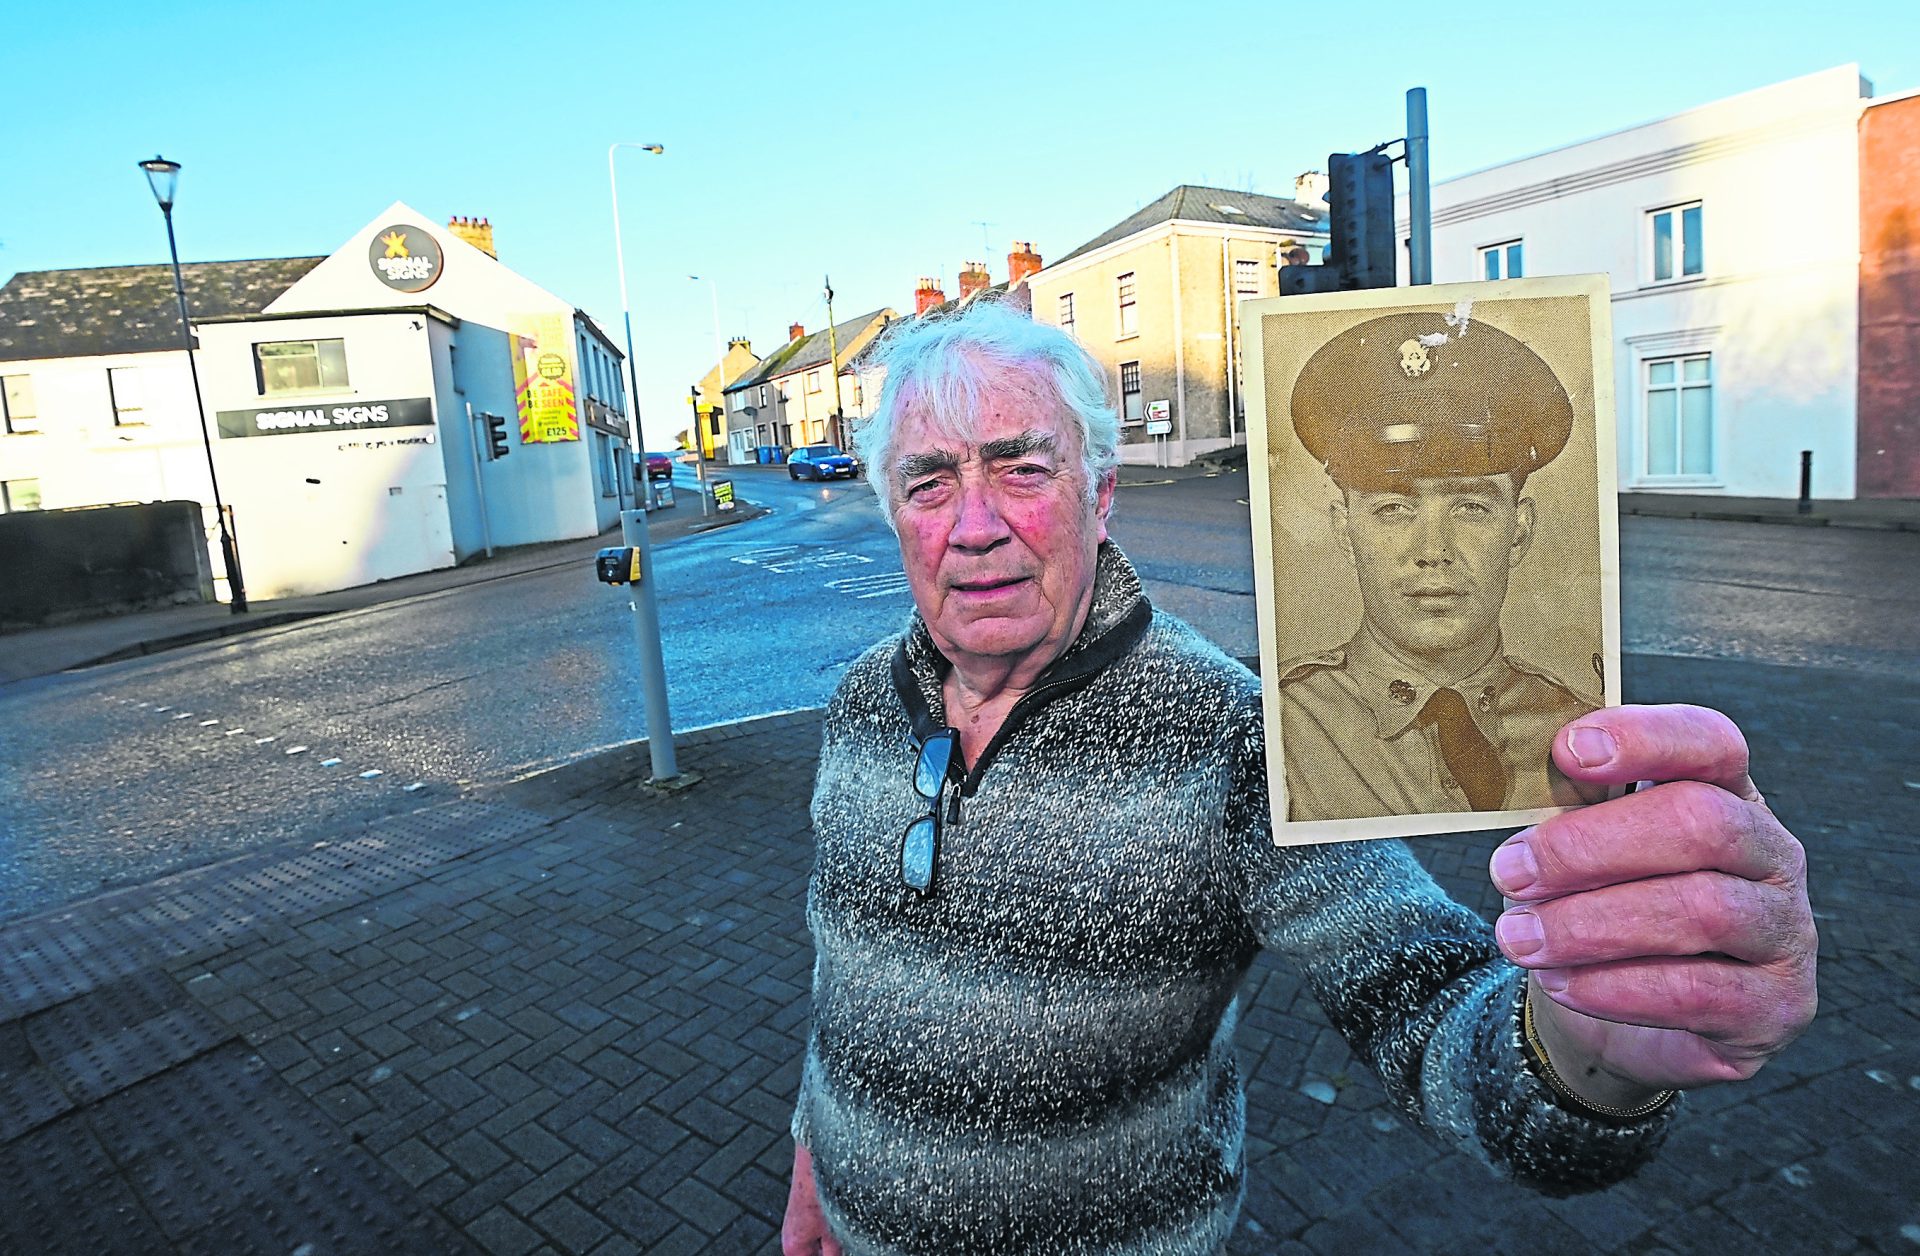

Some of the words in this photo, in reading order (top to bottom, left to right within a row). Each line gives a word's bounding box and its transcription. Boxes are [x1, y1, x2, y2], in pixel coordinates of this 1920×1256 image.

[378, 256, 433, 271] SIGNAL
[386, 266, 430, 280] SIGNS
[541, 389, 563, 398] SAFE
[542, 399, 565, 408] SEEN
[255, 410, 330, 430] SIGNAL
[332, 405, 389, 424] SIGNS
[546, 427, 567, 436] £125
